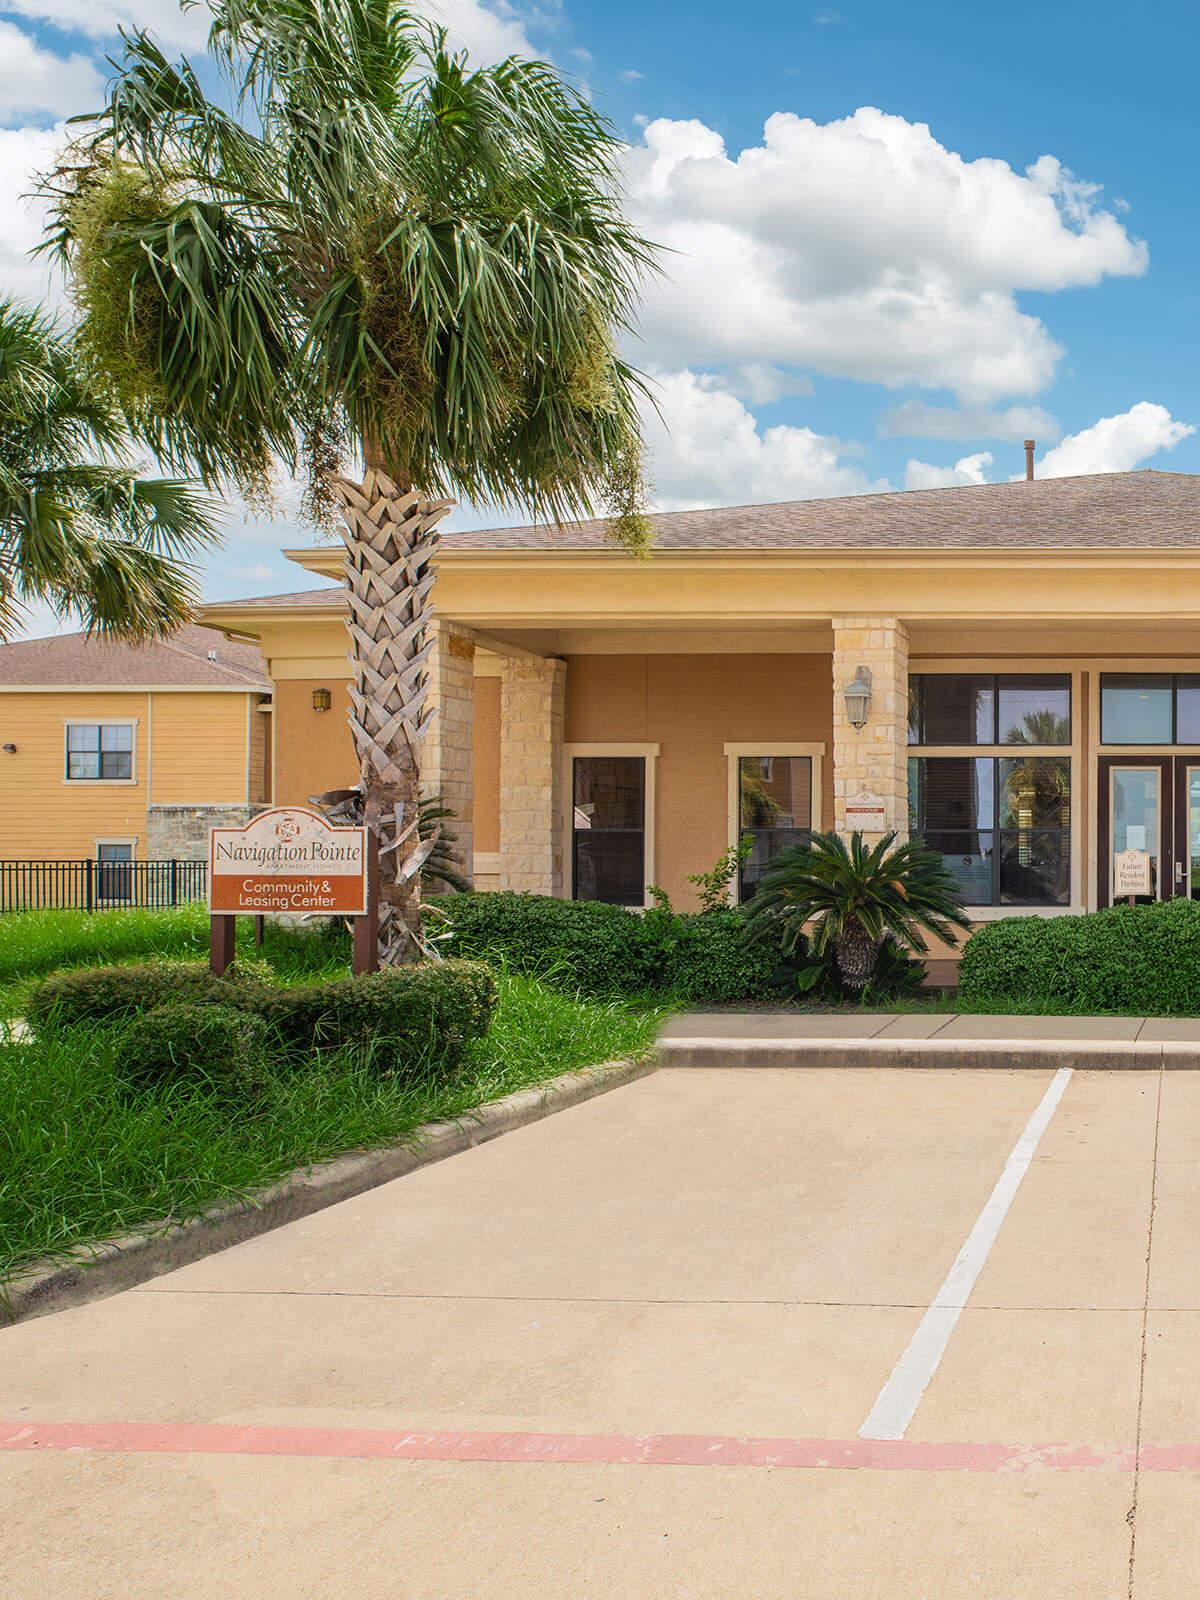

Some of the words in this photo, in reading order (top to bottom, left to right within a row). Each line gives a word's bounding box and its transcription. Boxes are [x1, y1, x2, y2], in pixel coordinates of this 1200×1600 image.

[216, 841, 308, 867] Navigation
[311, 841, 361, 861] Pointe
[243, 880, 320, 896] Community
[321, 880, 332, 893] &
[239, 894, 289, 909] Leasing
[291, 894, 336, 907] Center
